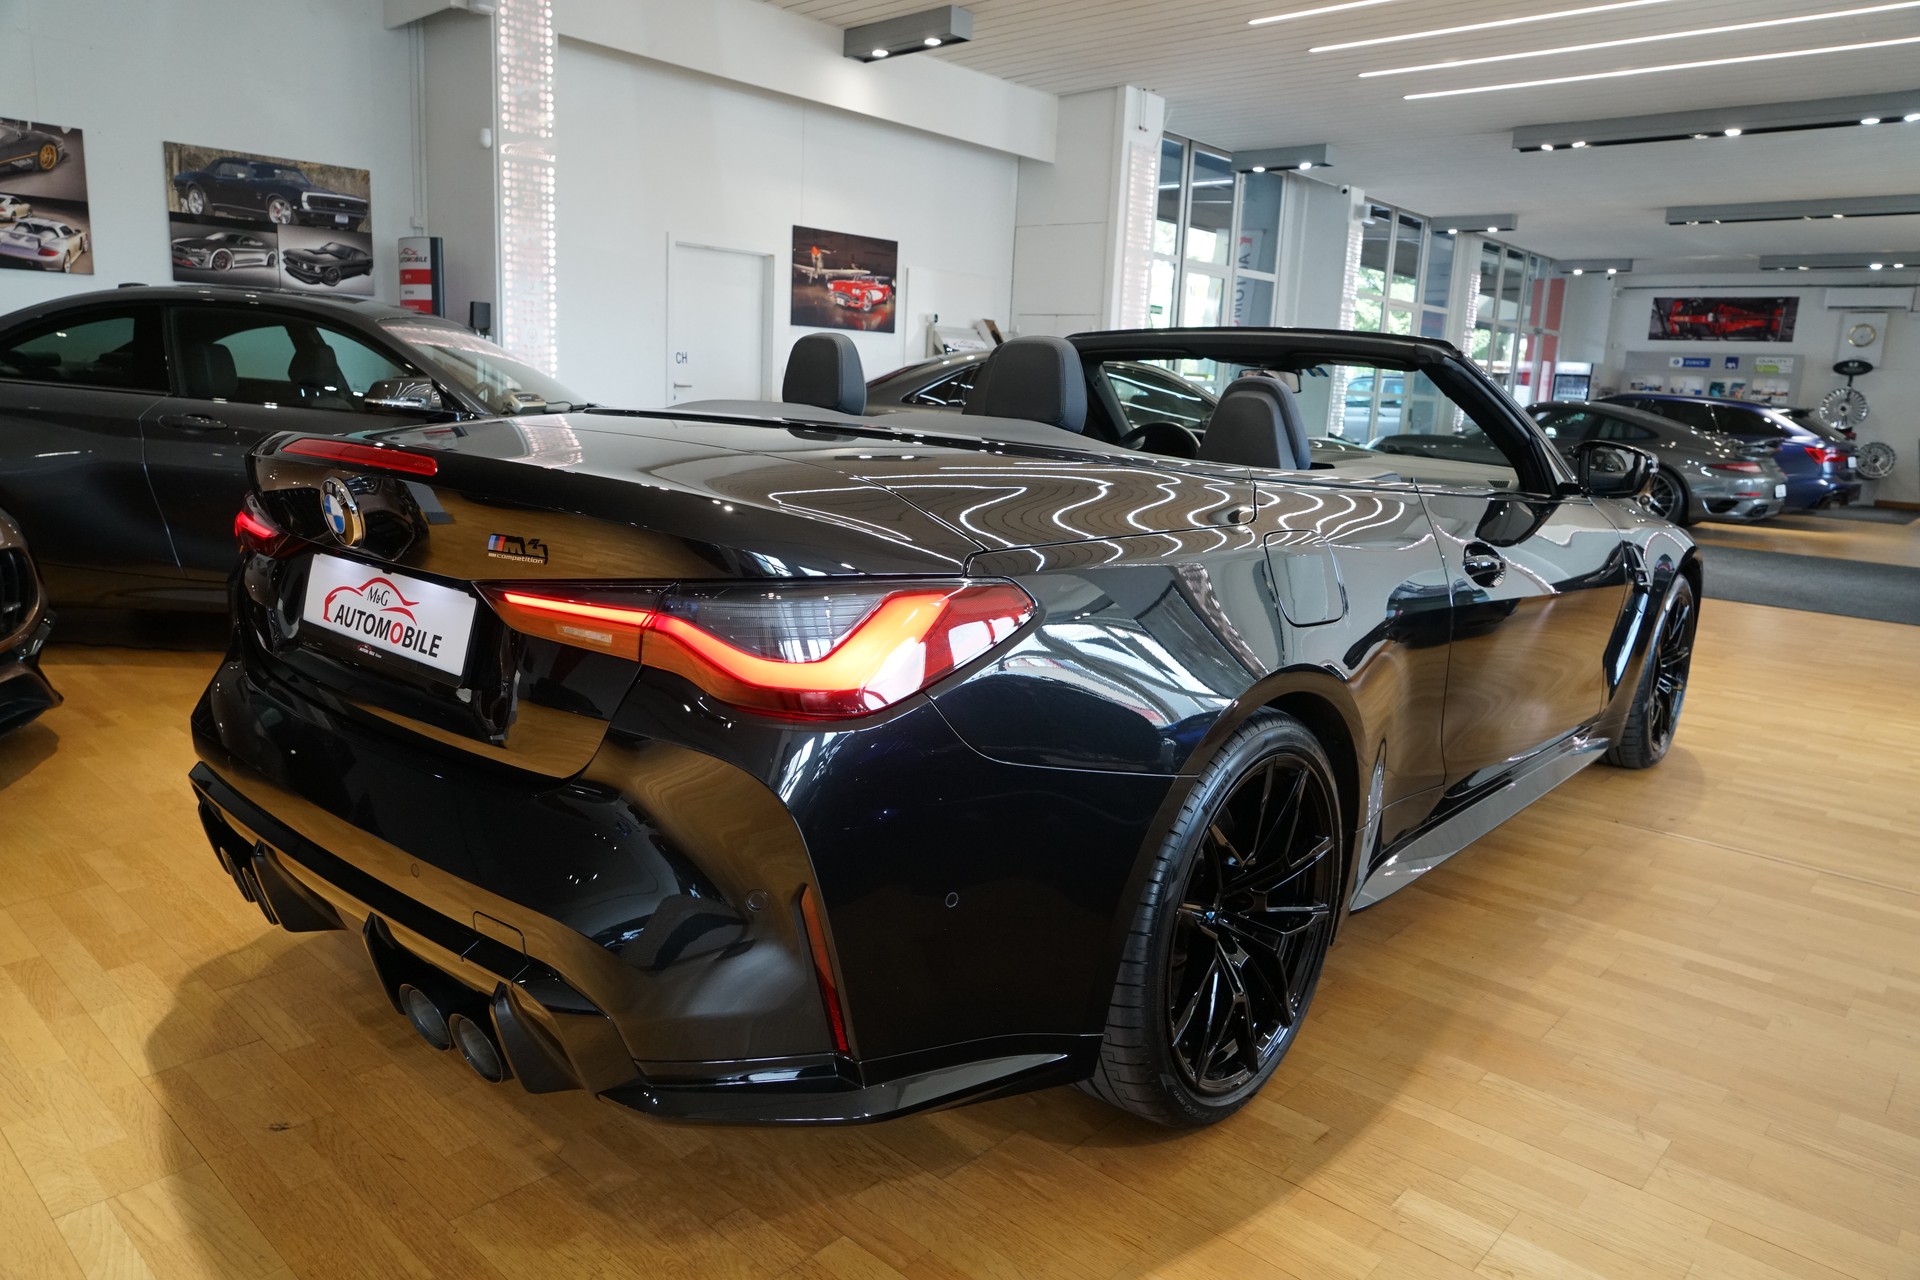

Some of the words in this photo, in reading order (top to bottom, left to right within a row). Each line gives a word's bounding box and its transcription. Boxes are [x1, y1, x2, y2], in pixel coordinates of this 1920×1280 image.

[675, 351, 688, 364] CH
[366, 586, 391, 606] M&G
[333, 604, 443, 658] AUTOMOBILE
